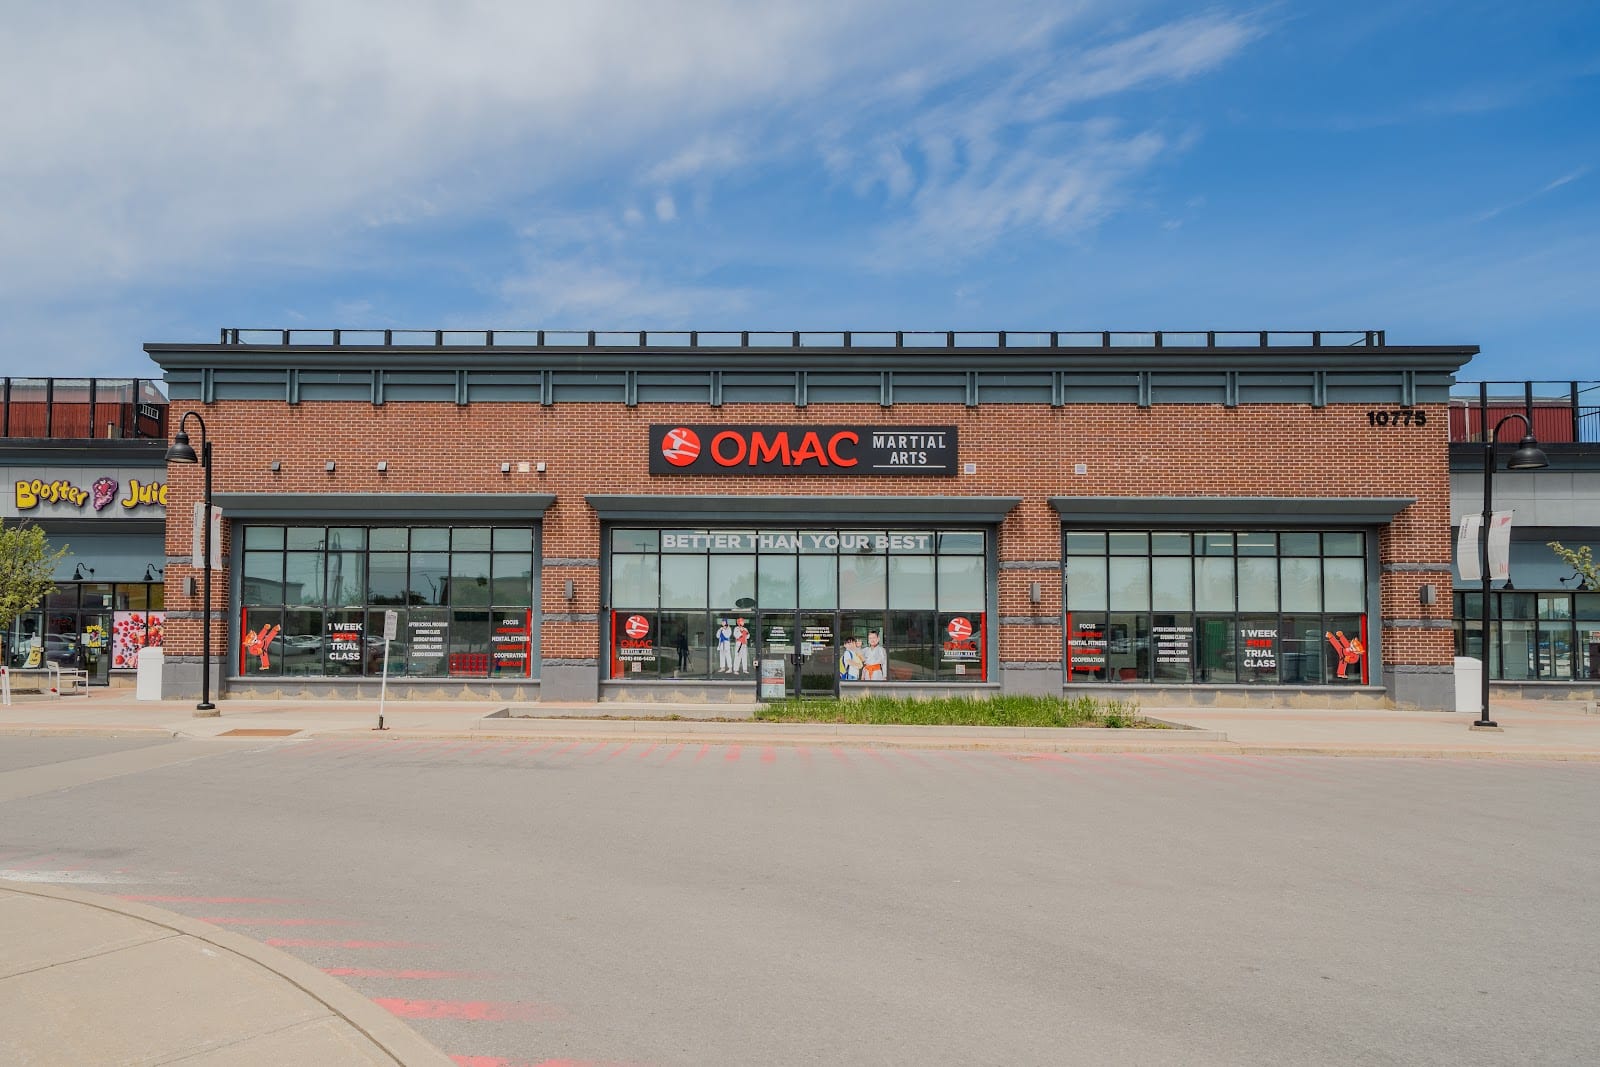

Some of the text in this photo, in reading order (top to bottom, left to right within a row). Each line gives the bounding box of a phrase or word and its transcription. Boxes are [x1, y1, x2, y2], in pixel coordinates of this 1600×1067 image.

[1367, 410, 1427, 426] 10775
[872, 435, 946, 449] MARTIAL
[710, 431, 859, 467] OMAC
[889, 451, 927, 465] ARTS
[16, 479, 167, 509] Booster Juic
[662, 534, 929, 550] BETTER THAN YOUR BEST
[327, 622, 363, 631] 1 WEEK
[1241, 629, 1278, 637] 1 WEEK
[330, 642, 359, 651] TRIAL
[620, 639, 653, 649] OMAC
[328, 652, 361, 661] CLASS
[1245, 649, 1275, 658] TRIAL
[1243, 659, 1277, 668] CLASS
